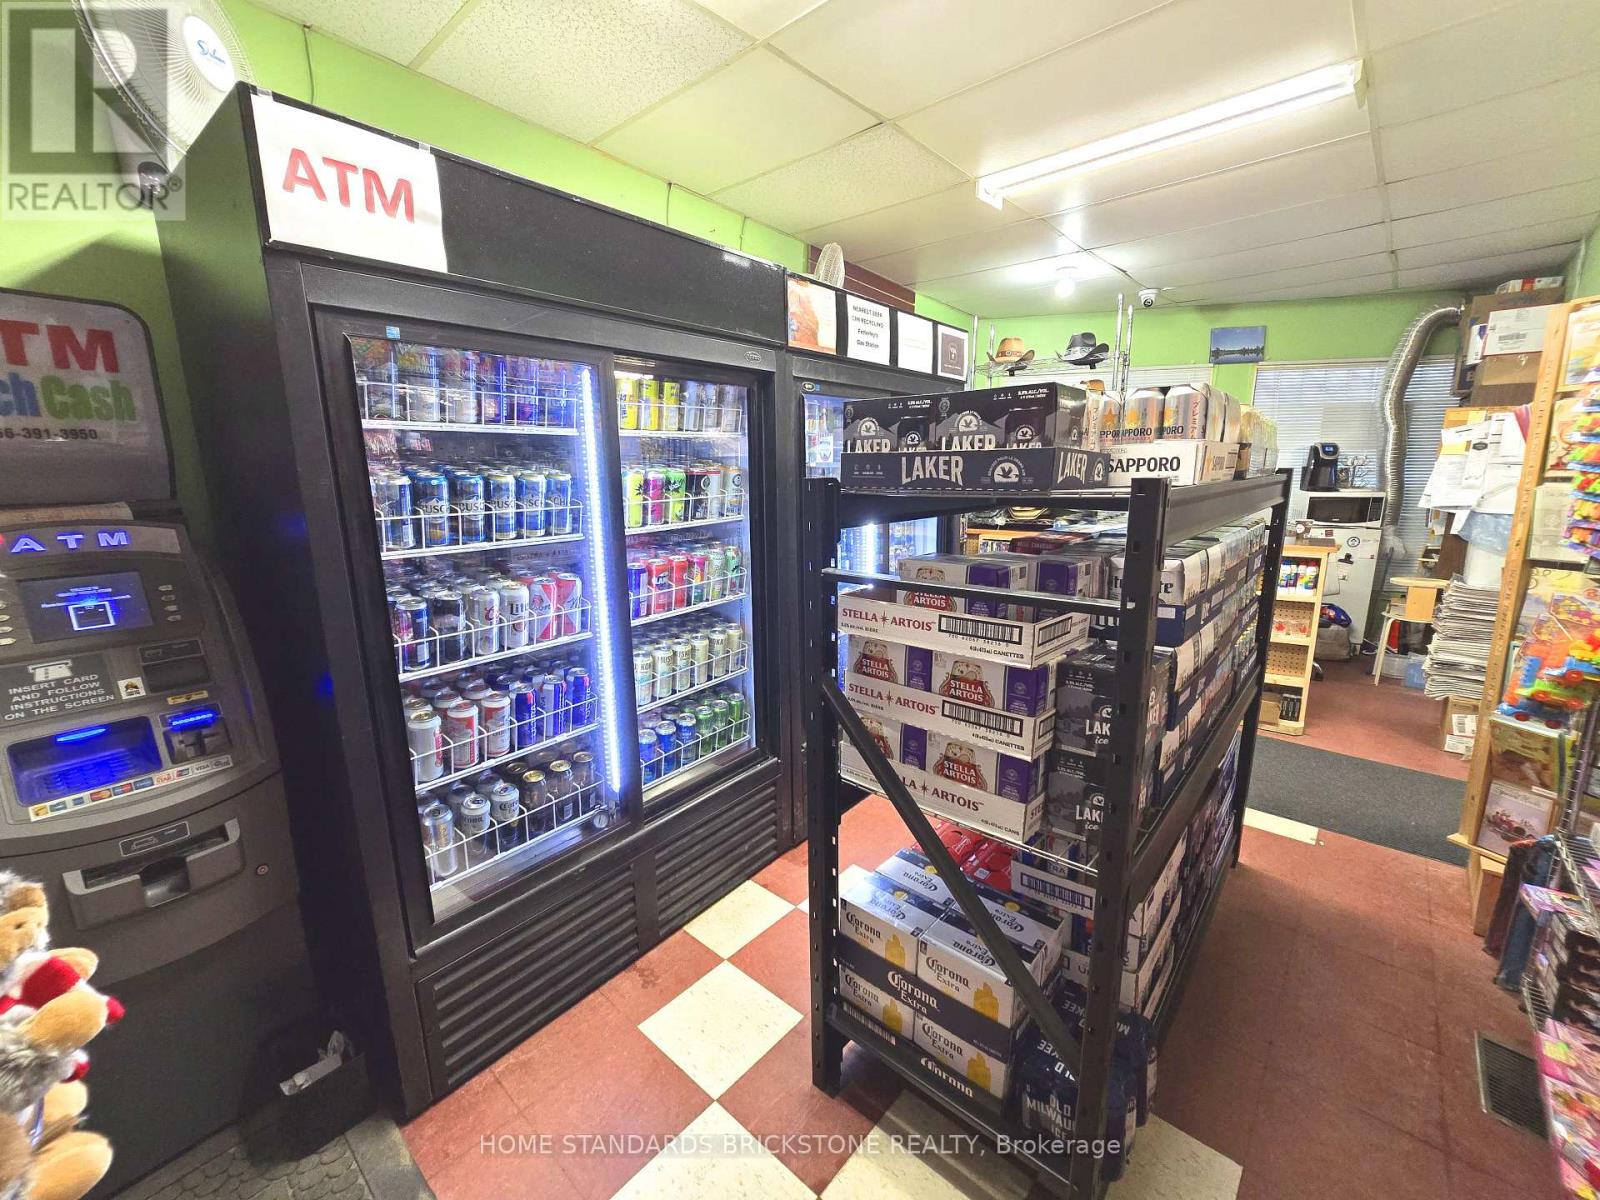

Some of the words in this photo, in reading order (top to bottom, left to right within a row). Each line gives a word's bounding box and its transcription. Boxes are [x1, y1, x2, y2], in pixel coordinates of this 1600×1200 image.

[282, 147, 416, 224] ATM
[941, 434, 996, 451] LAKER
[901, 455, 963, 486] LAKER
[1057, 451, 1088, 484] LAKER
[1108, 456, 1181, 473] SAPPORO
[11, 531, 130, 553] ATM
[510, 603, 524, 616] Lit
[914, 595, 947, 608] ARTOIS
[842, 608, 878, 622] STELLA
[890, 616, 932, 631] ARTOIS
[861, 658, 889, 671] STELLA
[993, 651, 1024, 659] CANETTES
[861, 666, 889, 679] ARTOIS
[9, 681, 56, 695] INSERT
[63, 674, 99, 685] CARD
[12, 692, 40, 703] AND
[47, 681, 100, 696] FOLLOW
[949, 687, 984, 702] ARTOIS
[950, 679, 983, 693] STELLA
[4, 712, 25, 721] ON
[32, 705, 58, 715] THE
[64, 694, 115, 709] SCREEN
[10, 688, 105, 711] INSTRUCTIONS
[848, 683, 884, 700] STELLA
[895, 696, 936, 715] ARTOIS
[1085, 719, 1112, 736] LAK
[995, 738, 1025, 751] CANETTES
[1095, 735, 1109, 745] ice
[943, 759, 976, 775] STELLA
[943, 768, 977, 784] ARTOIS
[931, 789, 979, 812] ARTOIS
[1075, 804, 1103, 824] LAK
[1004, 827, 1020, 836] CANS
[1084, 821, 1099, 831] ice
[903, 871, 939, 892] Corona
[846, 910, 881, 939] Corona
[854, 926, 875, 944] Extra
[952, 940, 996, 968] Corona
[926, 956, 970, 988] Corona
[936, 973, 960, 992] Extra
[845, 973, 879, 1003] Corona
[853, 988, 872, 1007] Extra
[888, 970, 939, 1009] Corona
[900, 990, 928, 1014] Extra
[922, 1022, 963, 1057] Corona
[931, 1039, 954, 1060] Extra
[920, 1057, 974, 1098] Corona
[1026, 1097, 1072, 1131] MILWAU
